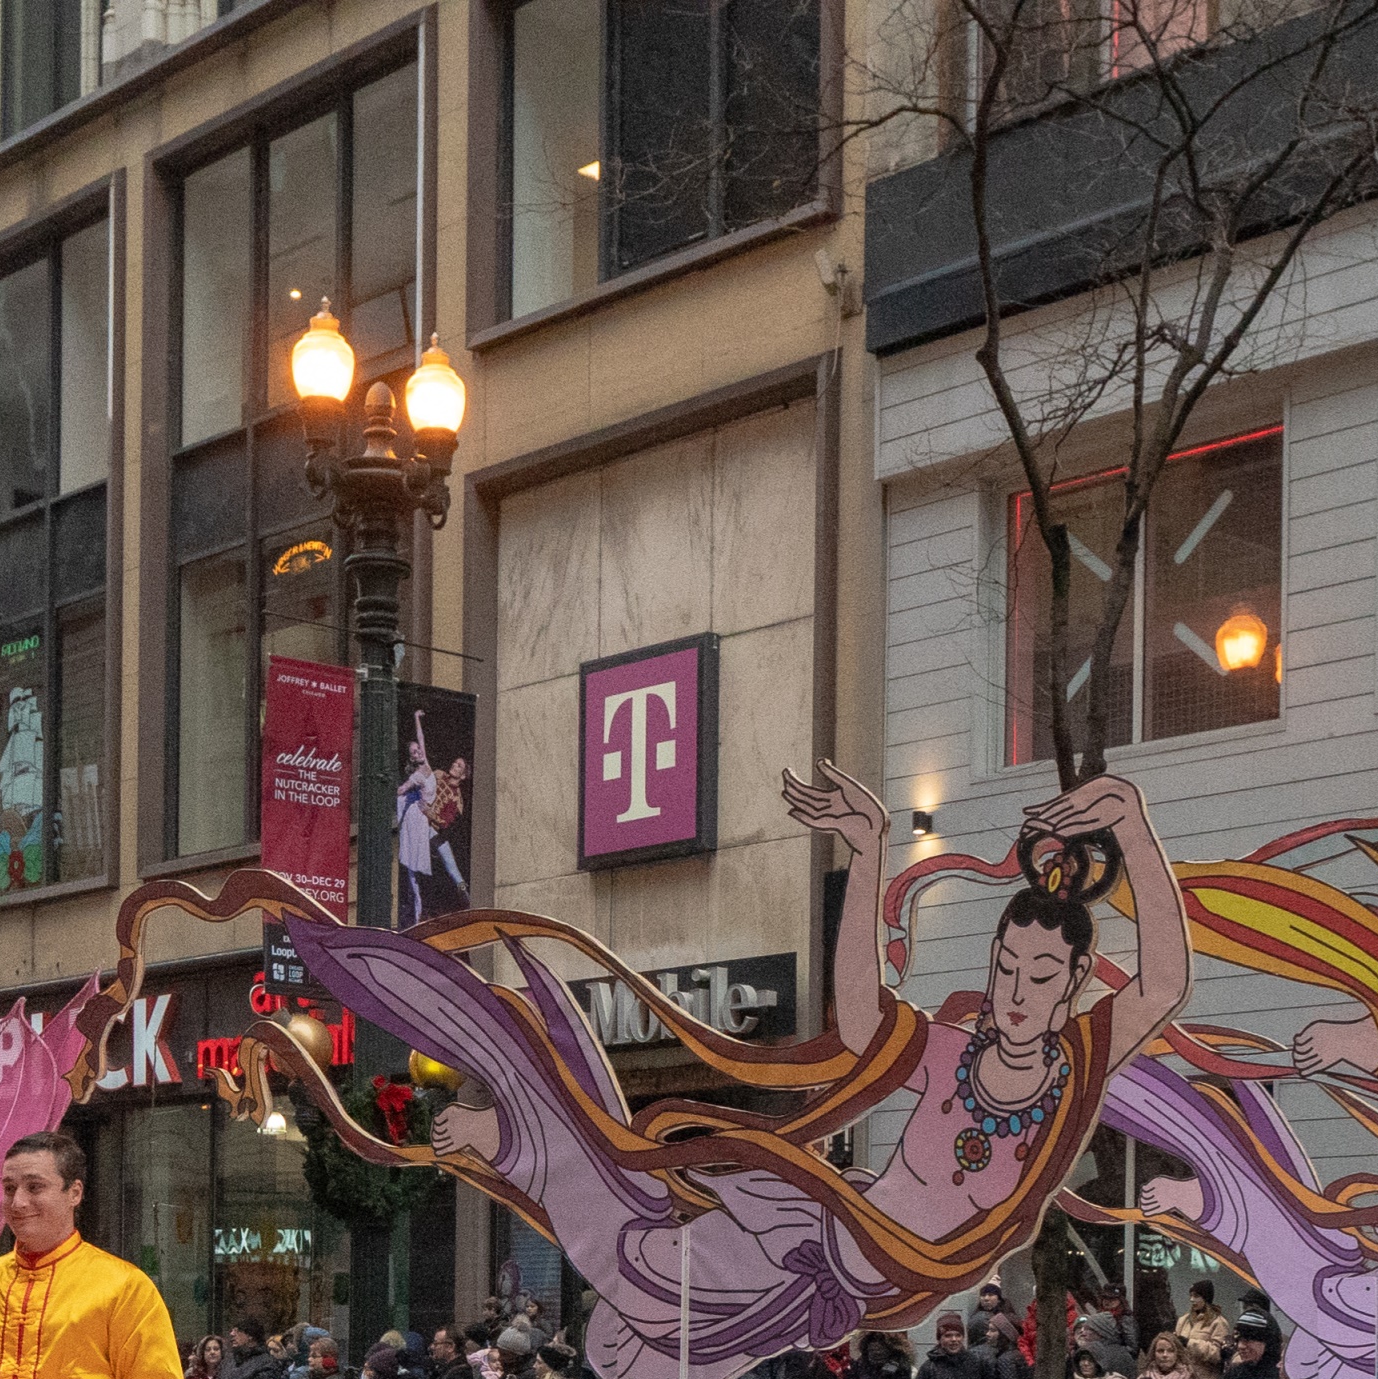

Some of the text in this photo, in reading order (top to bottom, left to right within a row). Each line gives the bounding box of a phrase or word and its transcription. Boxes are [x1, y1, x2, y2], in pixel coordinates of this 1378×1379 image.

[277, 674, 347, 694] JOFFREY BALLET
[276, 744, 343, 772] celebrate
[298, 769, 318, 780] THE
[274, 778, 341, 796] NUTCRACKER
[274, 790, 341, 808] IN THE LOOP
[334, 878, 346, 889] 29
